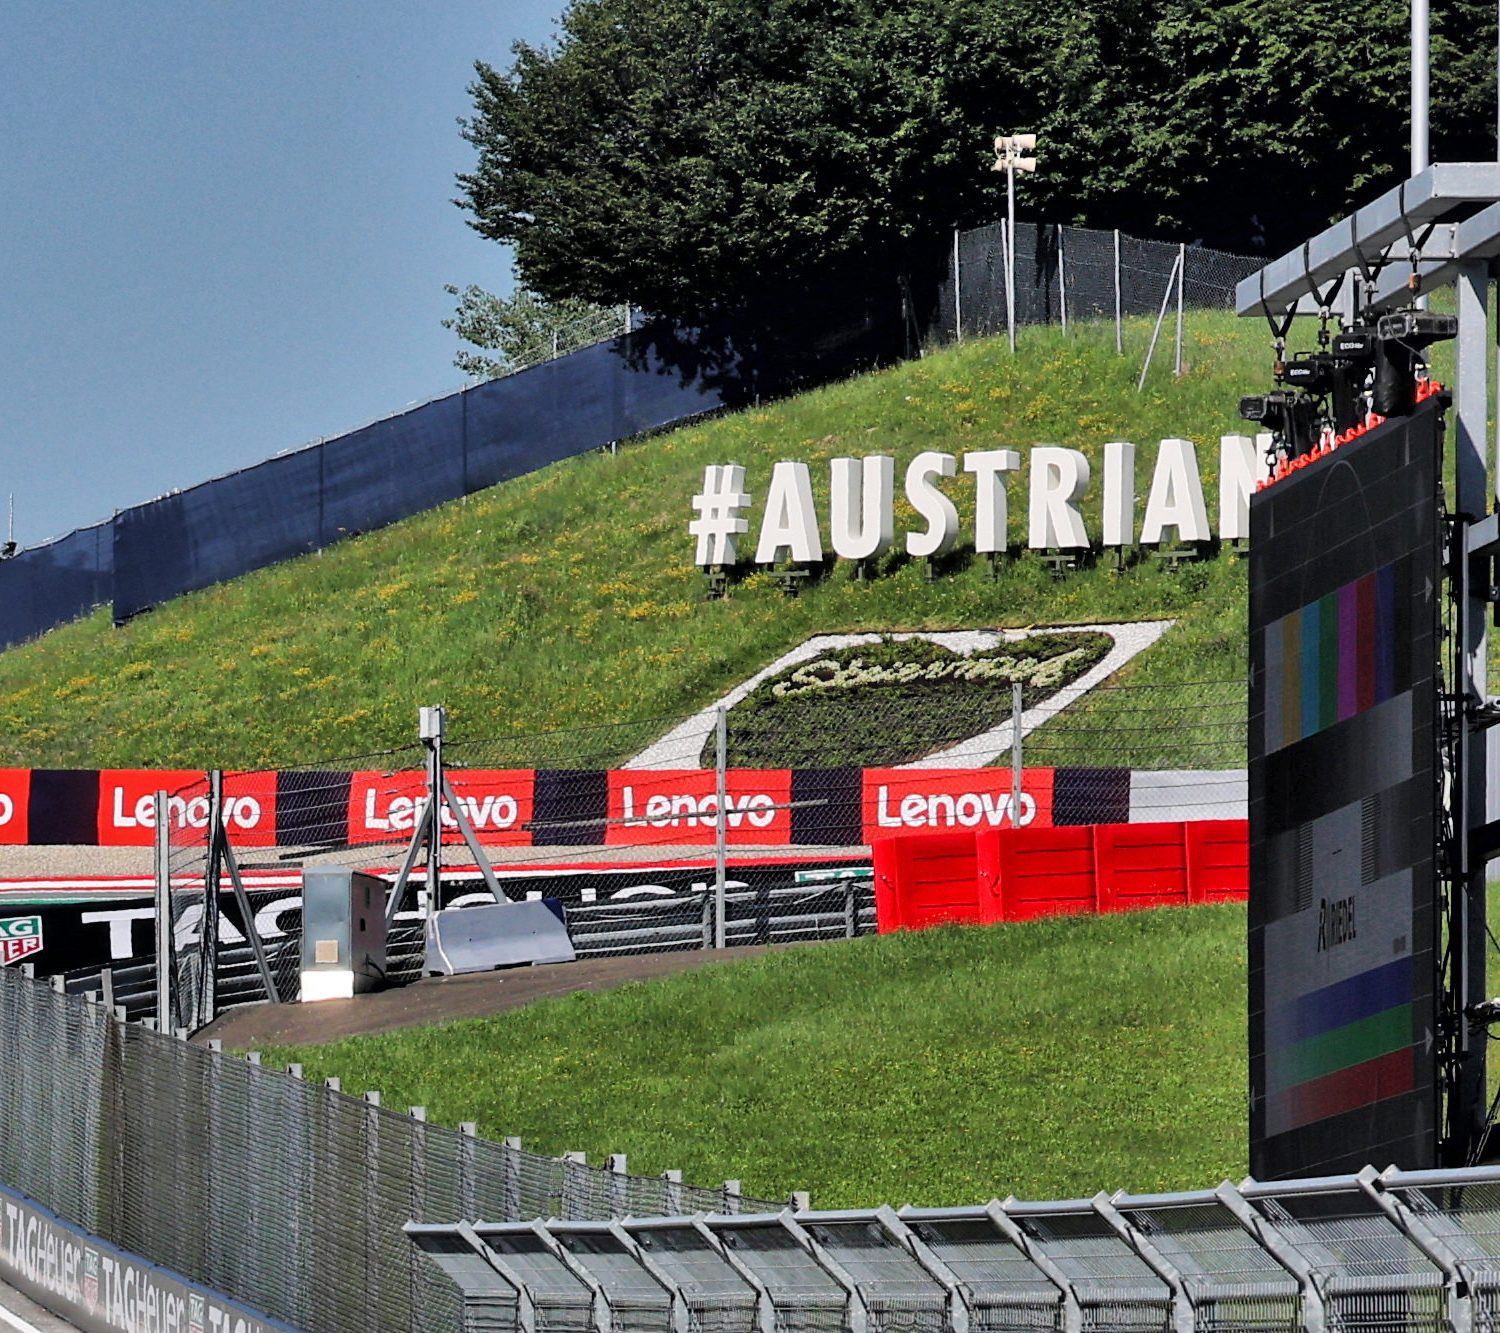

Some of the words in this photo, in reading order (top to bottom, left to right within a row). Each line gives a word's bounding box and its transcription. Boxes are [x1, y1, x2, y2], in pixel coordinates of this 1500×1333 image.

[113, 786, 260, 829] Lenovo
[364, 787, 518, 830] Lenovo
[622, 785, 775, 829] Lenovo
[877, 785, 1037, 829] Lenovo
